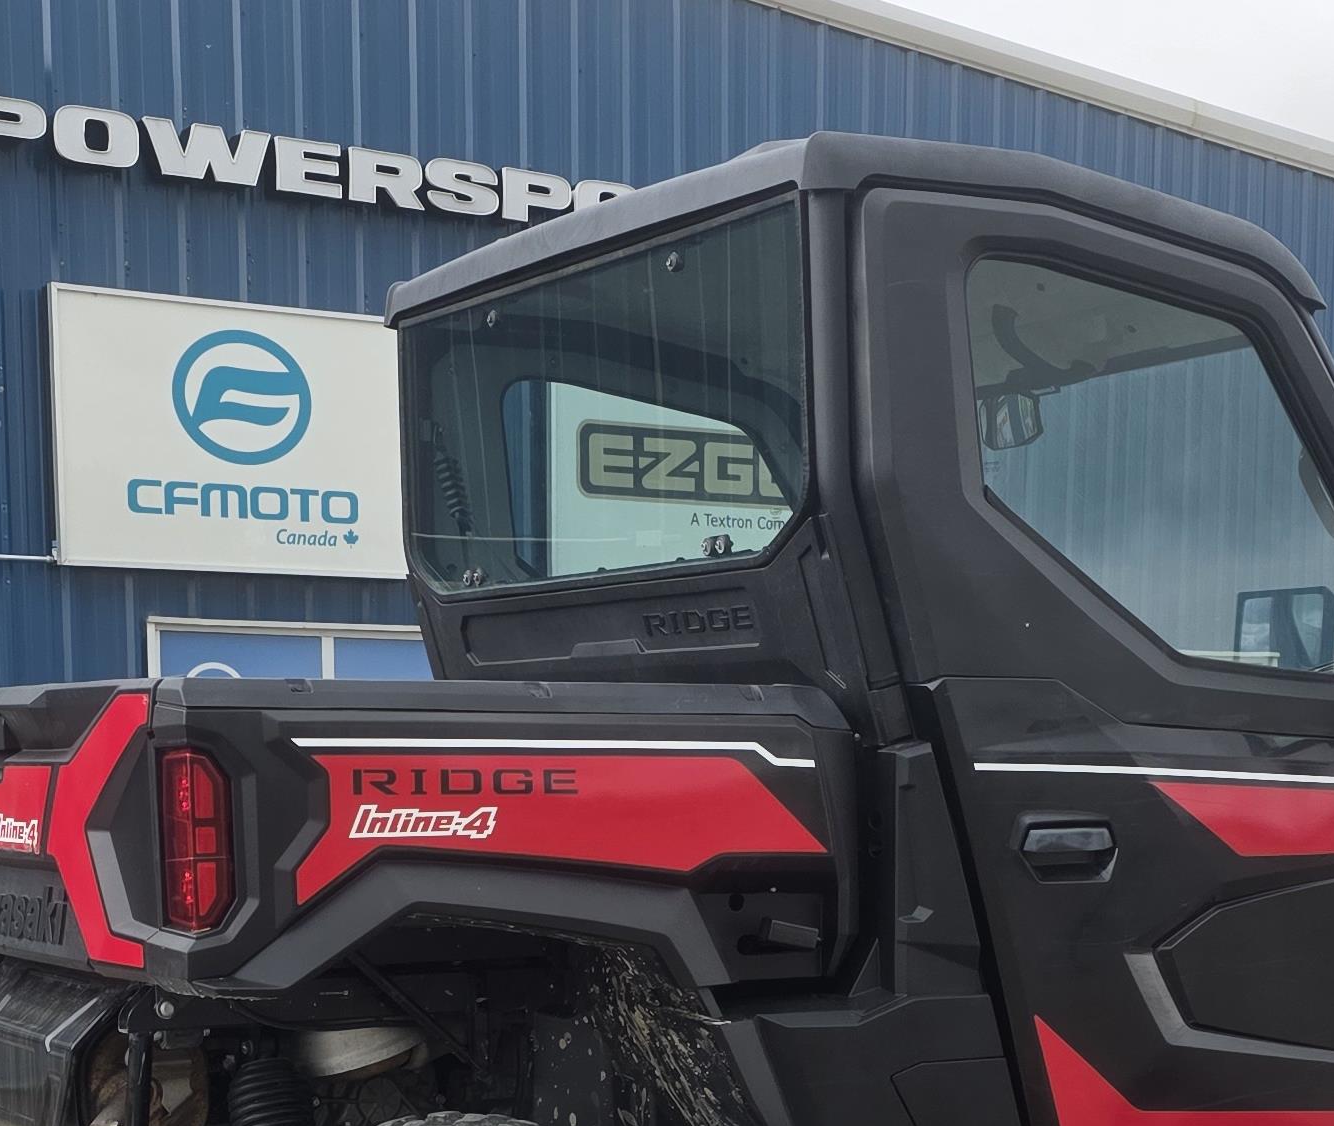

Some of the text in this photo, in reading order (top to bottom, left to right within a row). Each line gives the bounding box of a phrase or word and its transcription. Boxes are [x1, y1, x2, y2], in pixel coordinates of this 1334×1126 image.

[127, 478, 359, 525] CFMOTO
[690, 512, 700, 527] A
[703, 513, 753, 529] Textron
[276, 528, 338, 547] Canada
[642, 605, 754, 637] RIDGE
[352, 768, 579, 796] RIDGE
[349, 804, 498, 839] Inline-4
